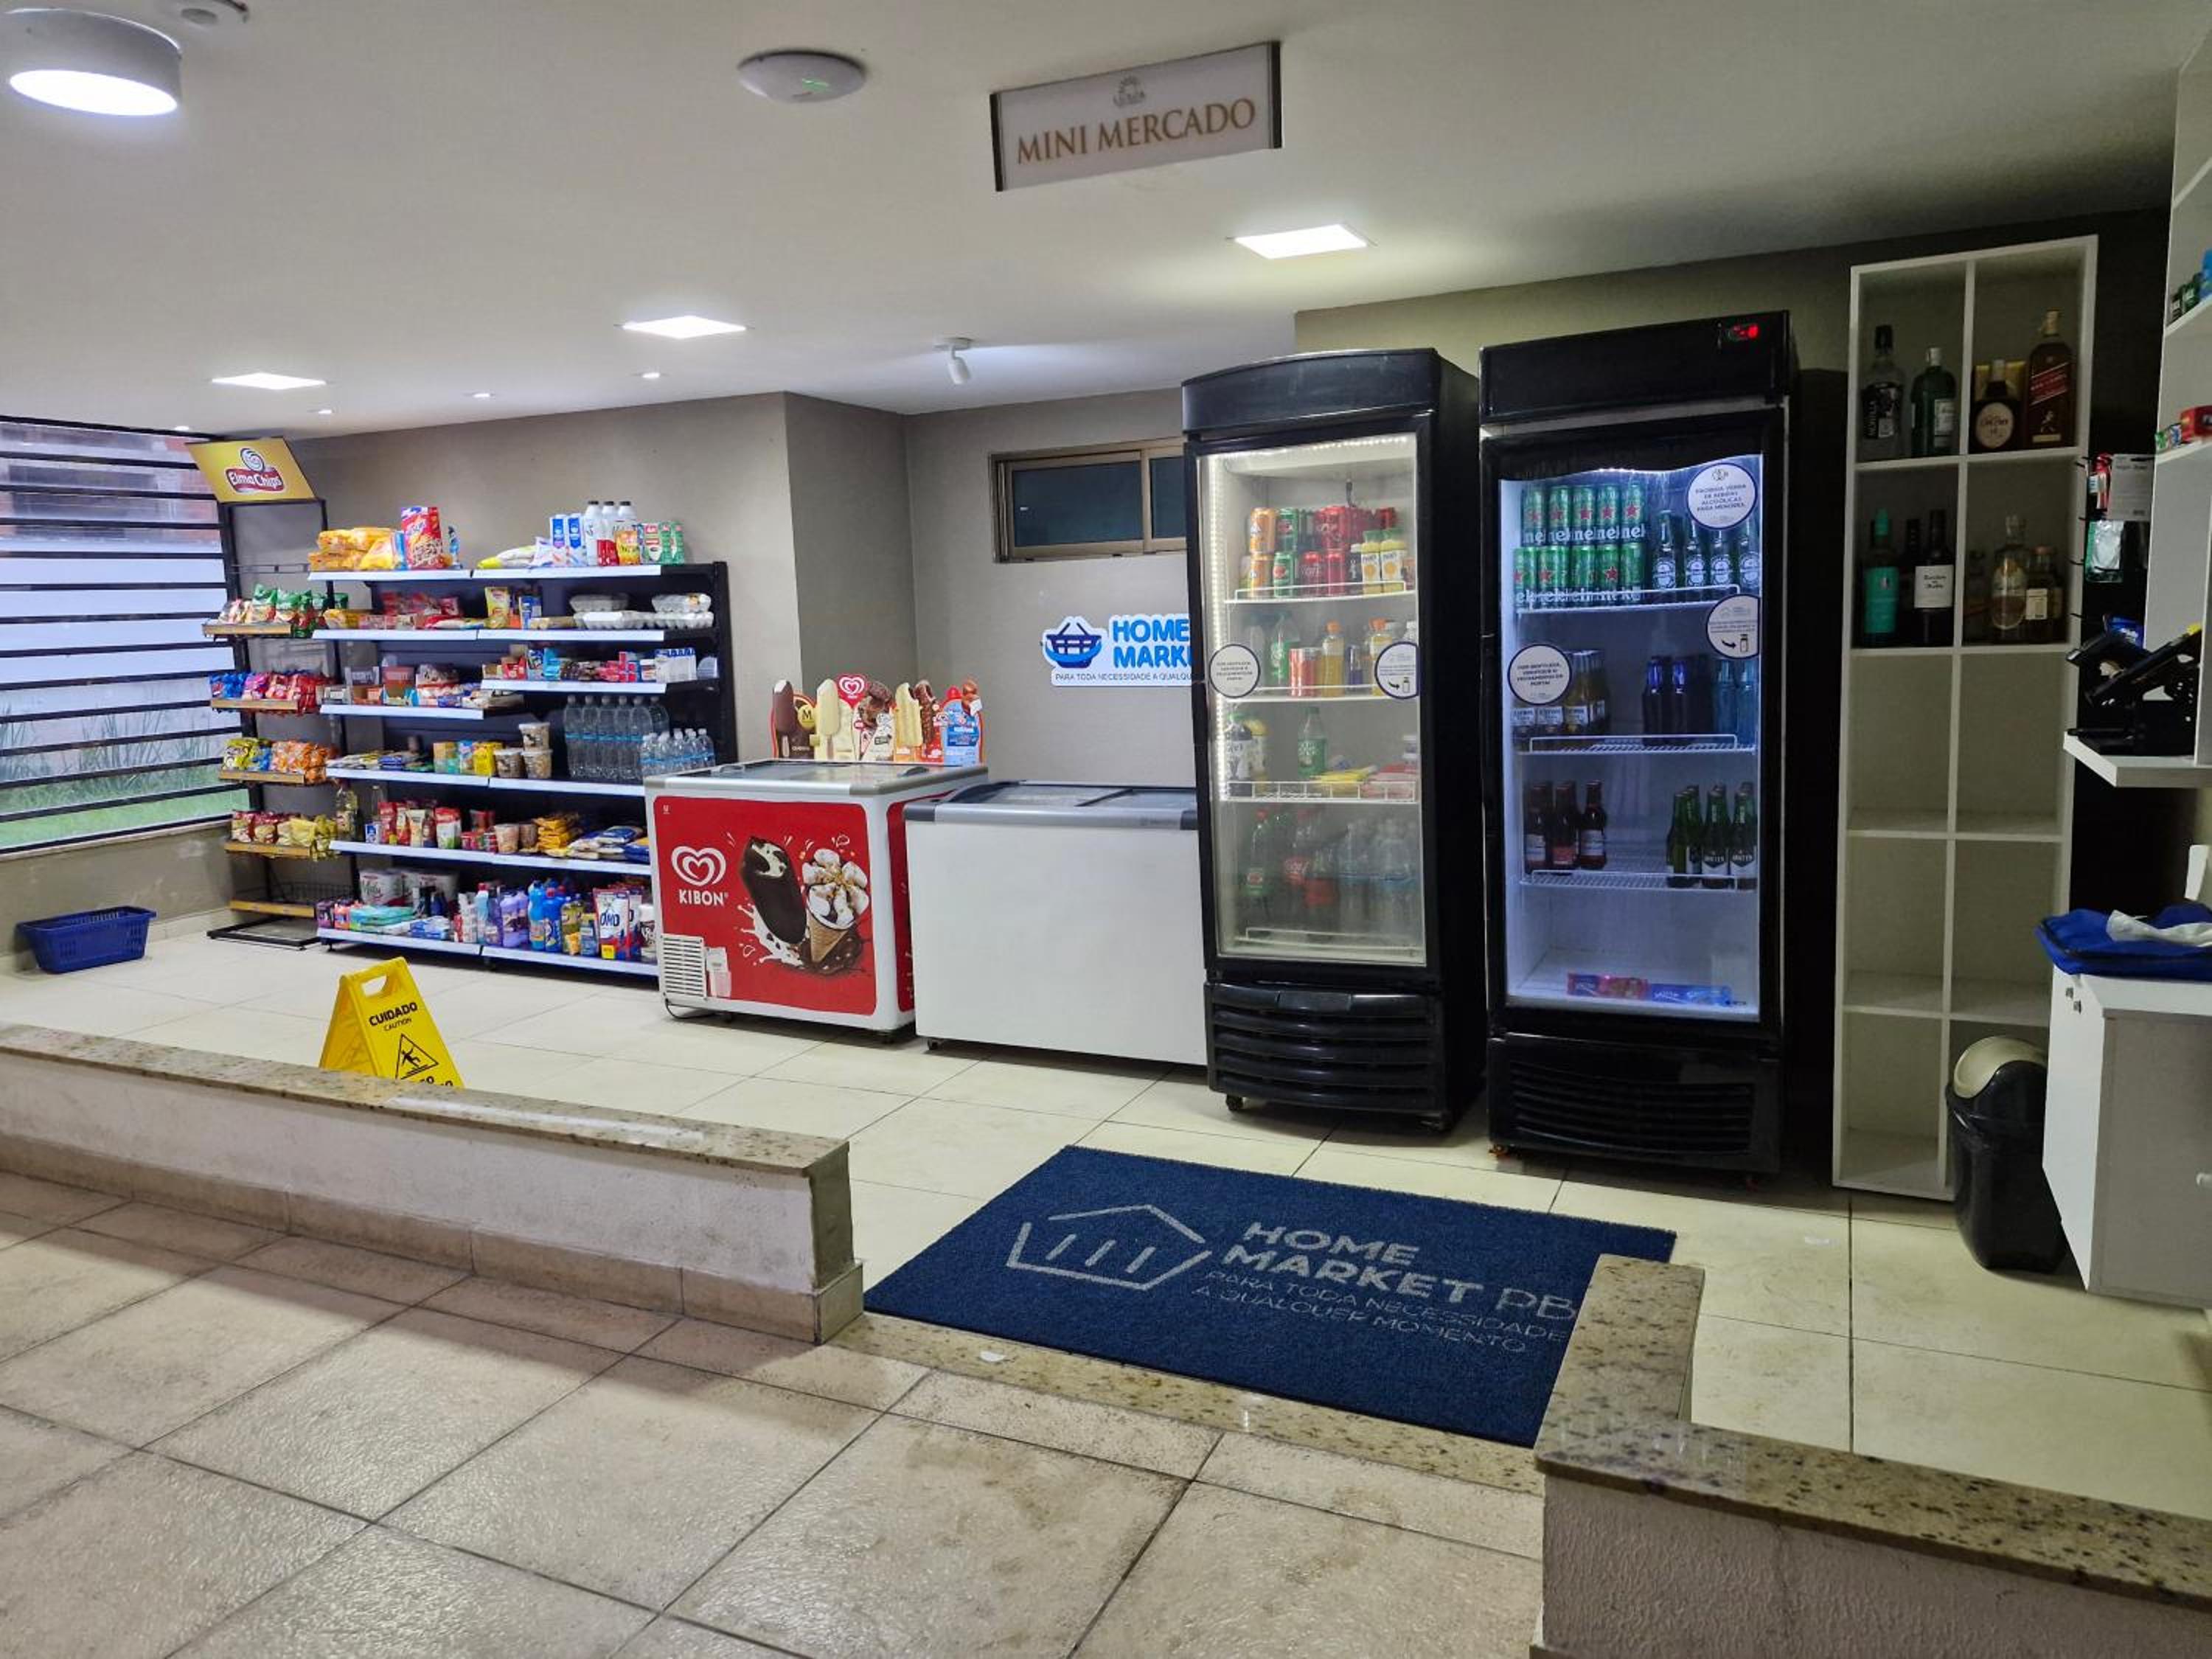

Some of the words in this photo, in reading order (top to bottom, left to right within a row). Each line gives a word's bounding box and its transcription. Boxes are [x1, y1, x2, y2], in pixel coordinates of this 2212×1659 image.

[1018, 125, 1088, 164] MINI
[1098, 98, 1256, 152] MERCADO
[1112, 619, 1189, 643] HOME
[1055, 672, 1074, 681] PARA
[1077, 672, 1097, 681] TODA
[679, 889, 725, 906] KIBON
[600, 913, 620, 927] OMO
[369, 1001, 418, 1026] CUIDADO
[384, 1018, 412, 1032] CAUTION
[1242, 1222, 1420, 1265] HOME
[1221, 1245, 1484, 1304] MARKET
[1495, 1287, 1576, 1320] PB
[1191, 1285, 1210, 1296] A
[1220, 1290, 1367, 1321] QUALQUER
[1372, 1316, 1526, 1352] MOMENTO
[1206, 1270, 1274, 1291] PARA
[1287, 1283, 1357, 1306] TODA
[1365, 1298, 1567, 1342] NECESSIDADE
